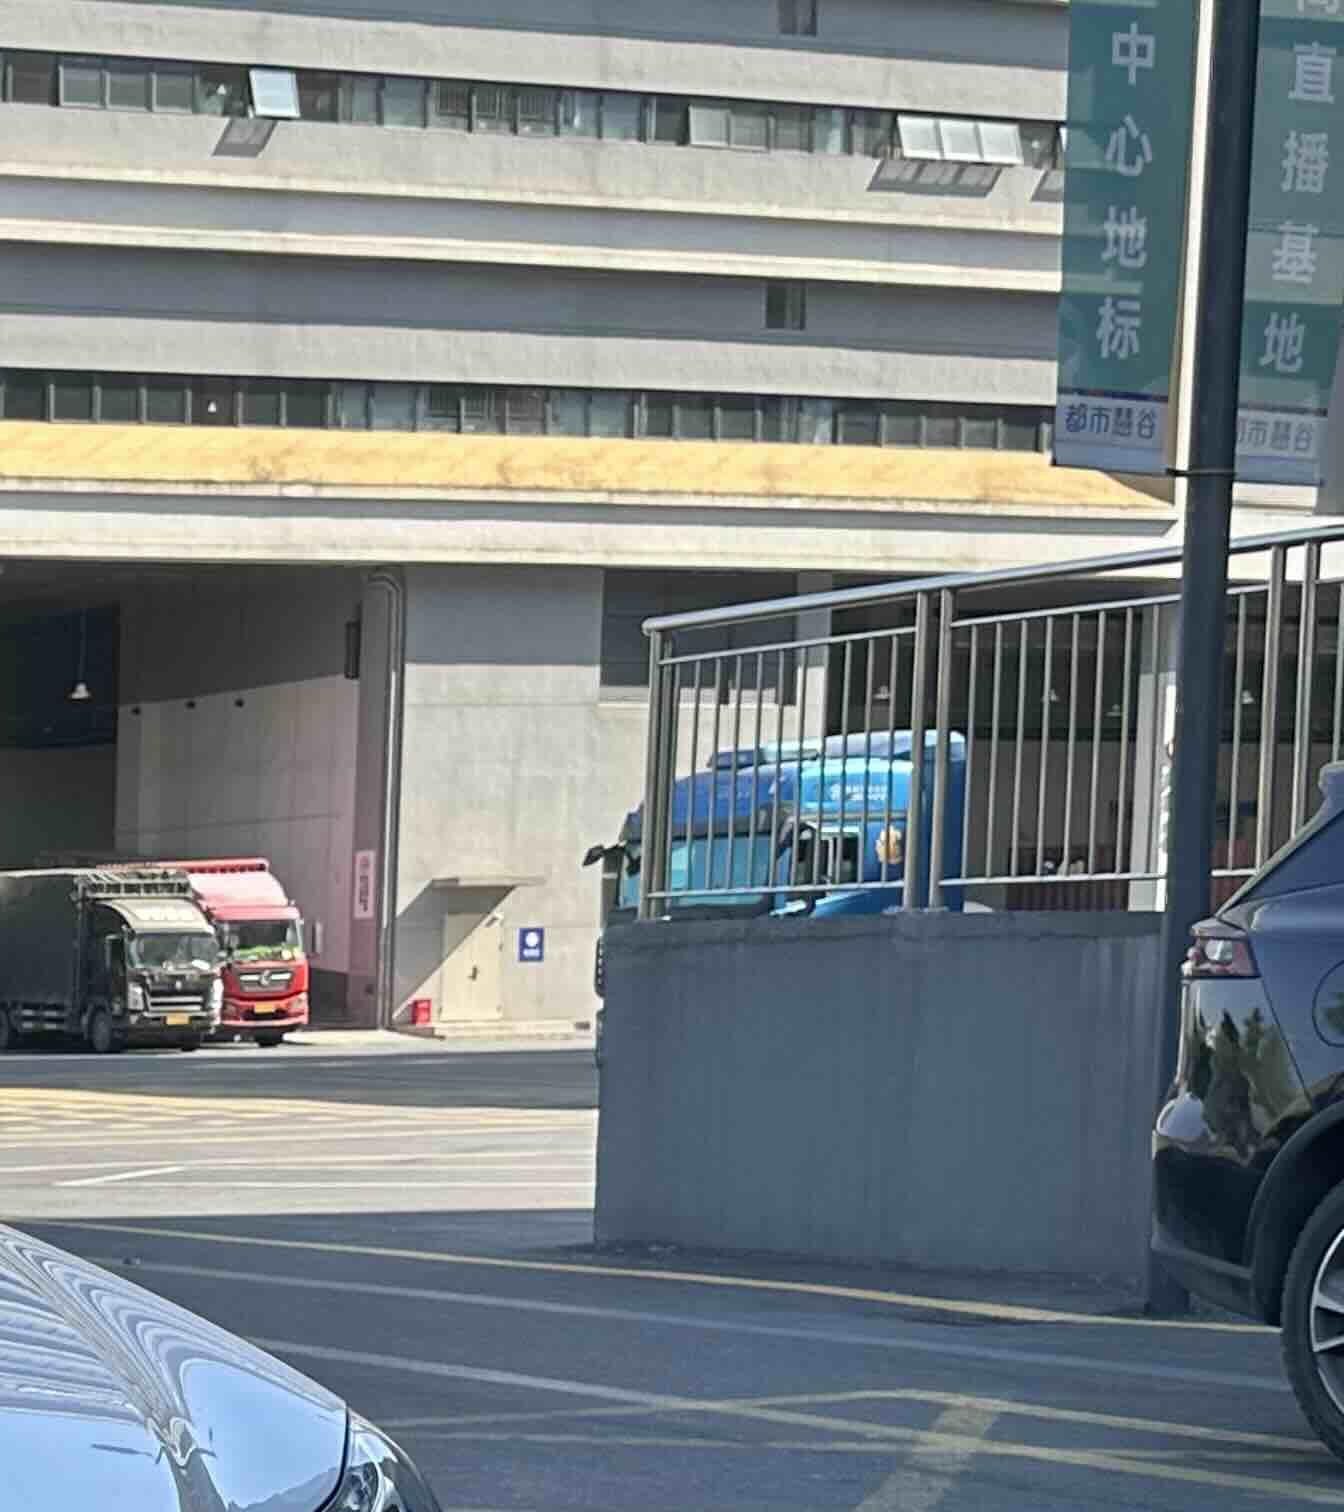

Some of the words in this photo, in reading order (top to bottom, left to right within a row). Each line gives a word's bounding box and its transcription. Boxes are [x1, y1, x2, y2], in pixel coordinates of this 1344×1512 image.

[1095, 22, 1155, 362] 中心地标
[1258, 0, 1340, 375] 直播基地
